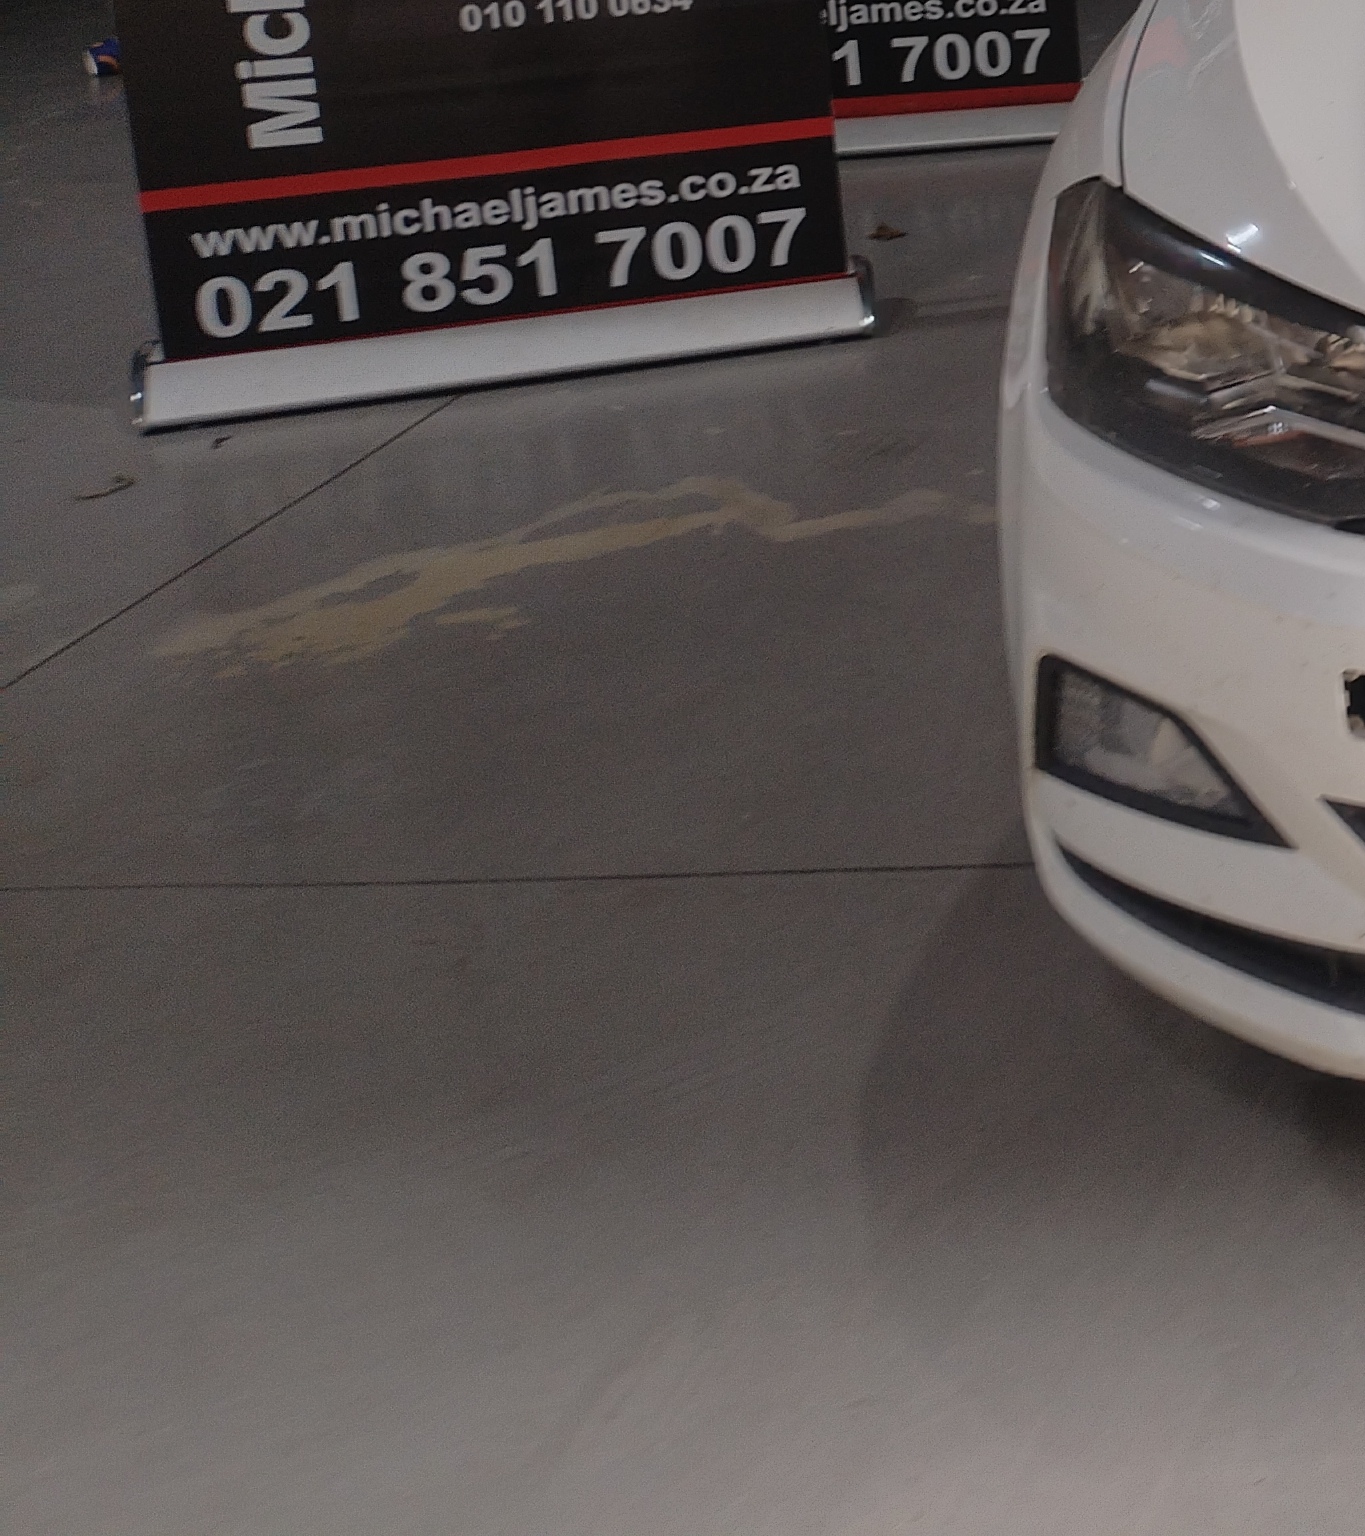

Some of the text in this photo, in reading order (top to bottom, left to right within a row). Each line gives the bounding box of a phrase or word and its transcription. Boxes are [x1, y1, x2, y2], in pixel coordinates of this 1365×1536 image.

[459, 0, 526, 32] 010
[891, 28, 1050, 82] 7007
[190, 162, 801, 261] www.michaeljames.co.za
[196, 208, 806, 337] 021 851 7007
